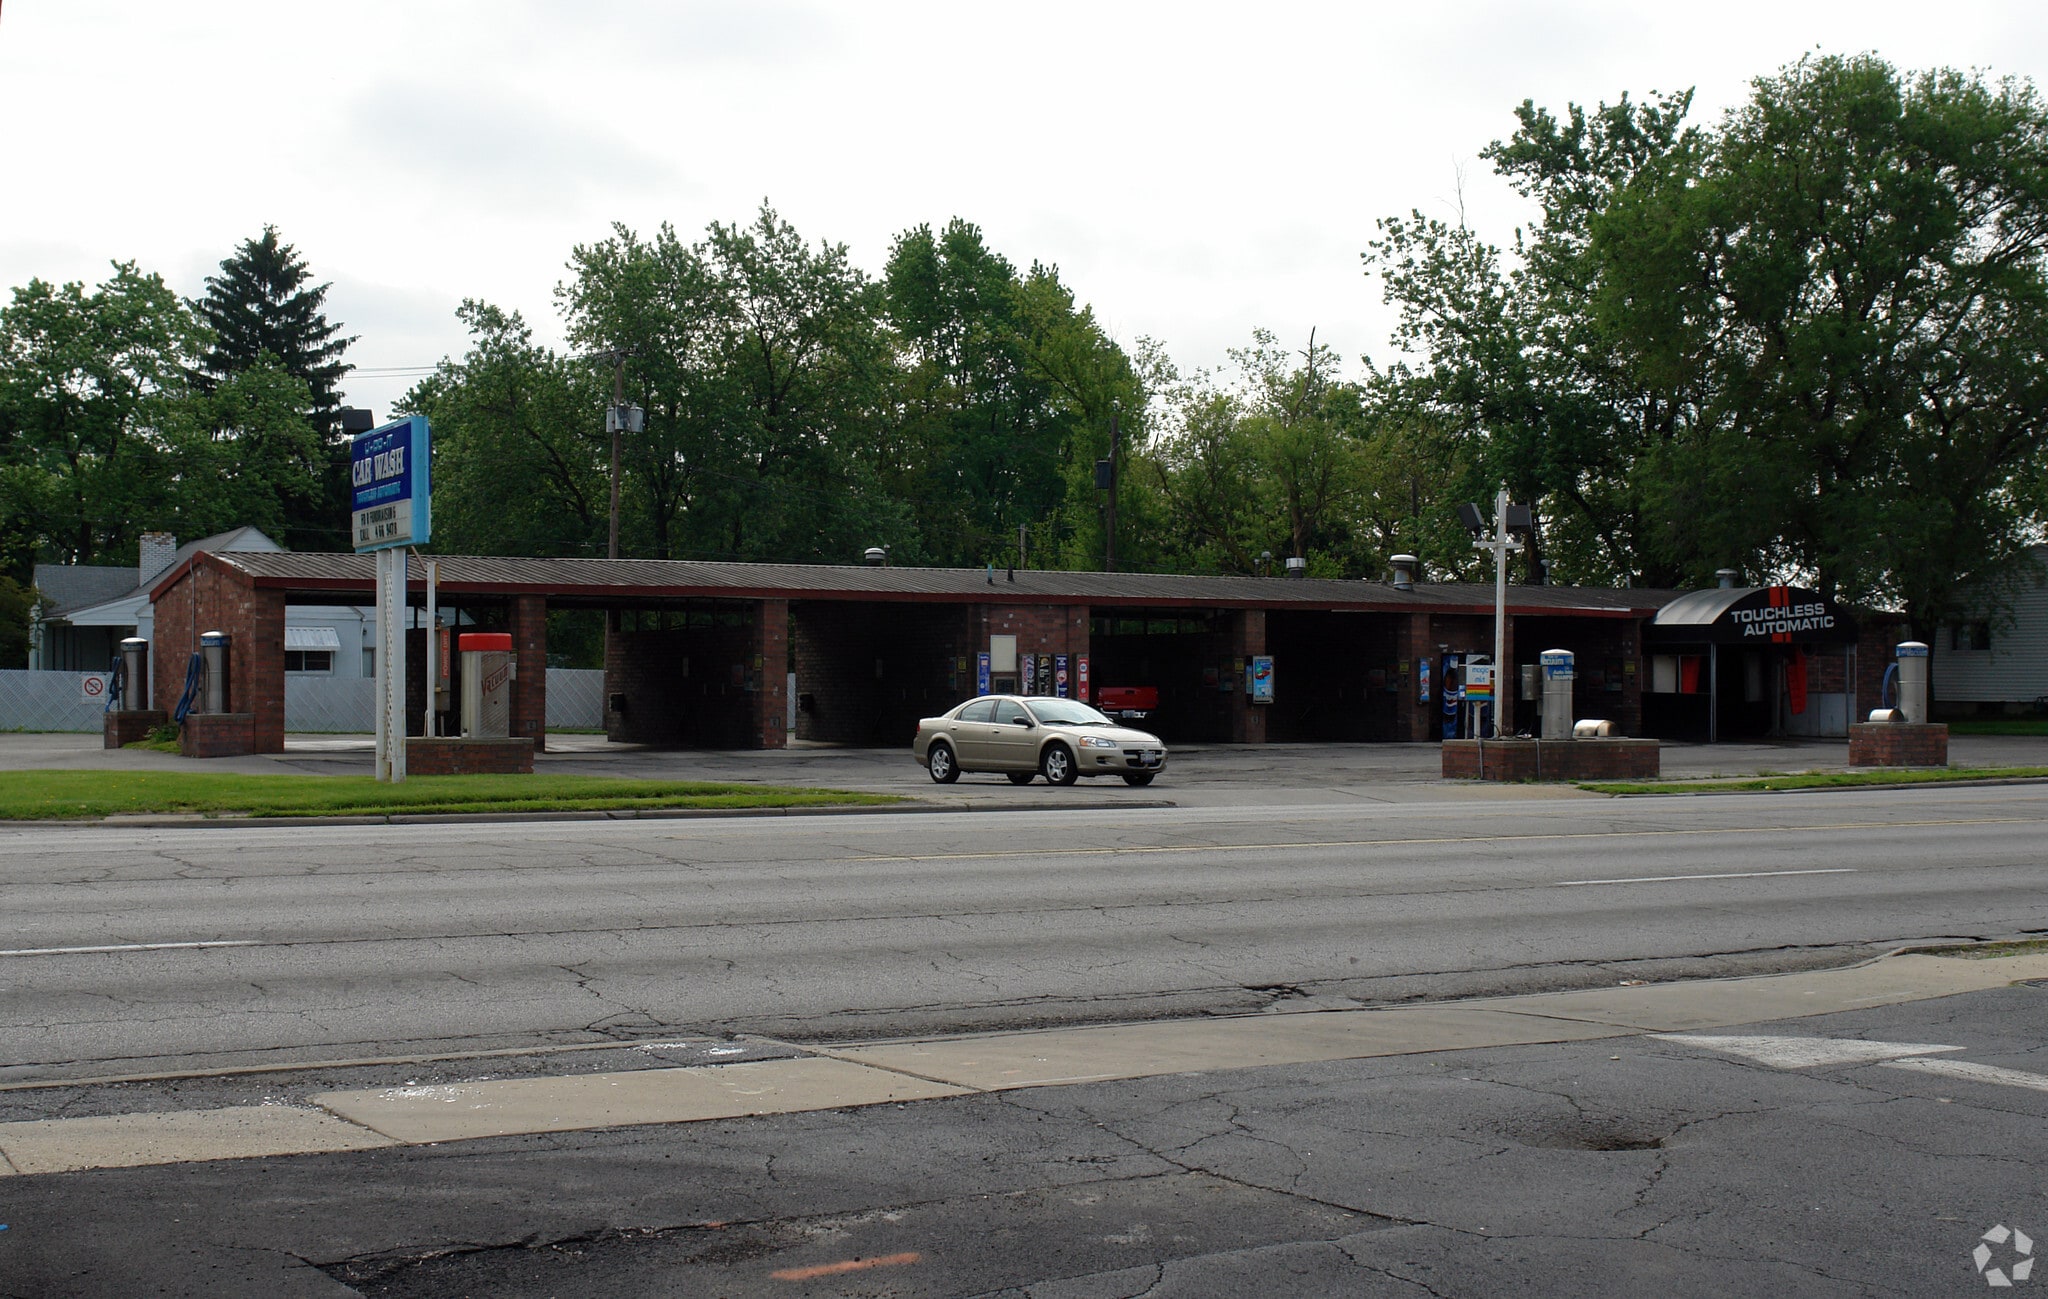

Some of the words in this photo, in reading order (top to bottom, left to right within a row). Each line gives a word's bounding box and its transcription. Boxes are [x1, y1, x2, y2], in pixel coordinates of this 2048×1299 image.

[365, 434, 393, 454] U-DO-IT
[353, 457, 372, 488] CAR
[374, 446, 404, 481] WASH
[1731, 603, 1825, 623] TOUCHLESS
[1744, 616, 1834, 637] AUTOMATIC
